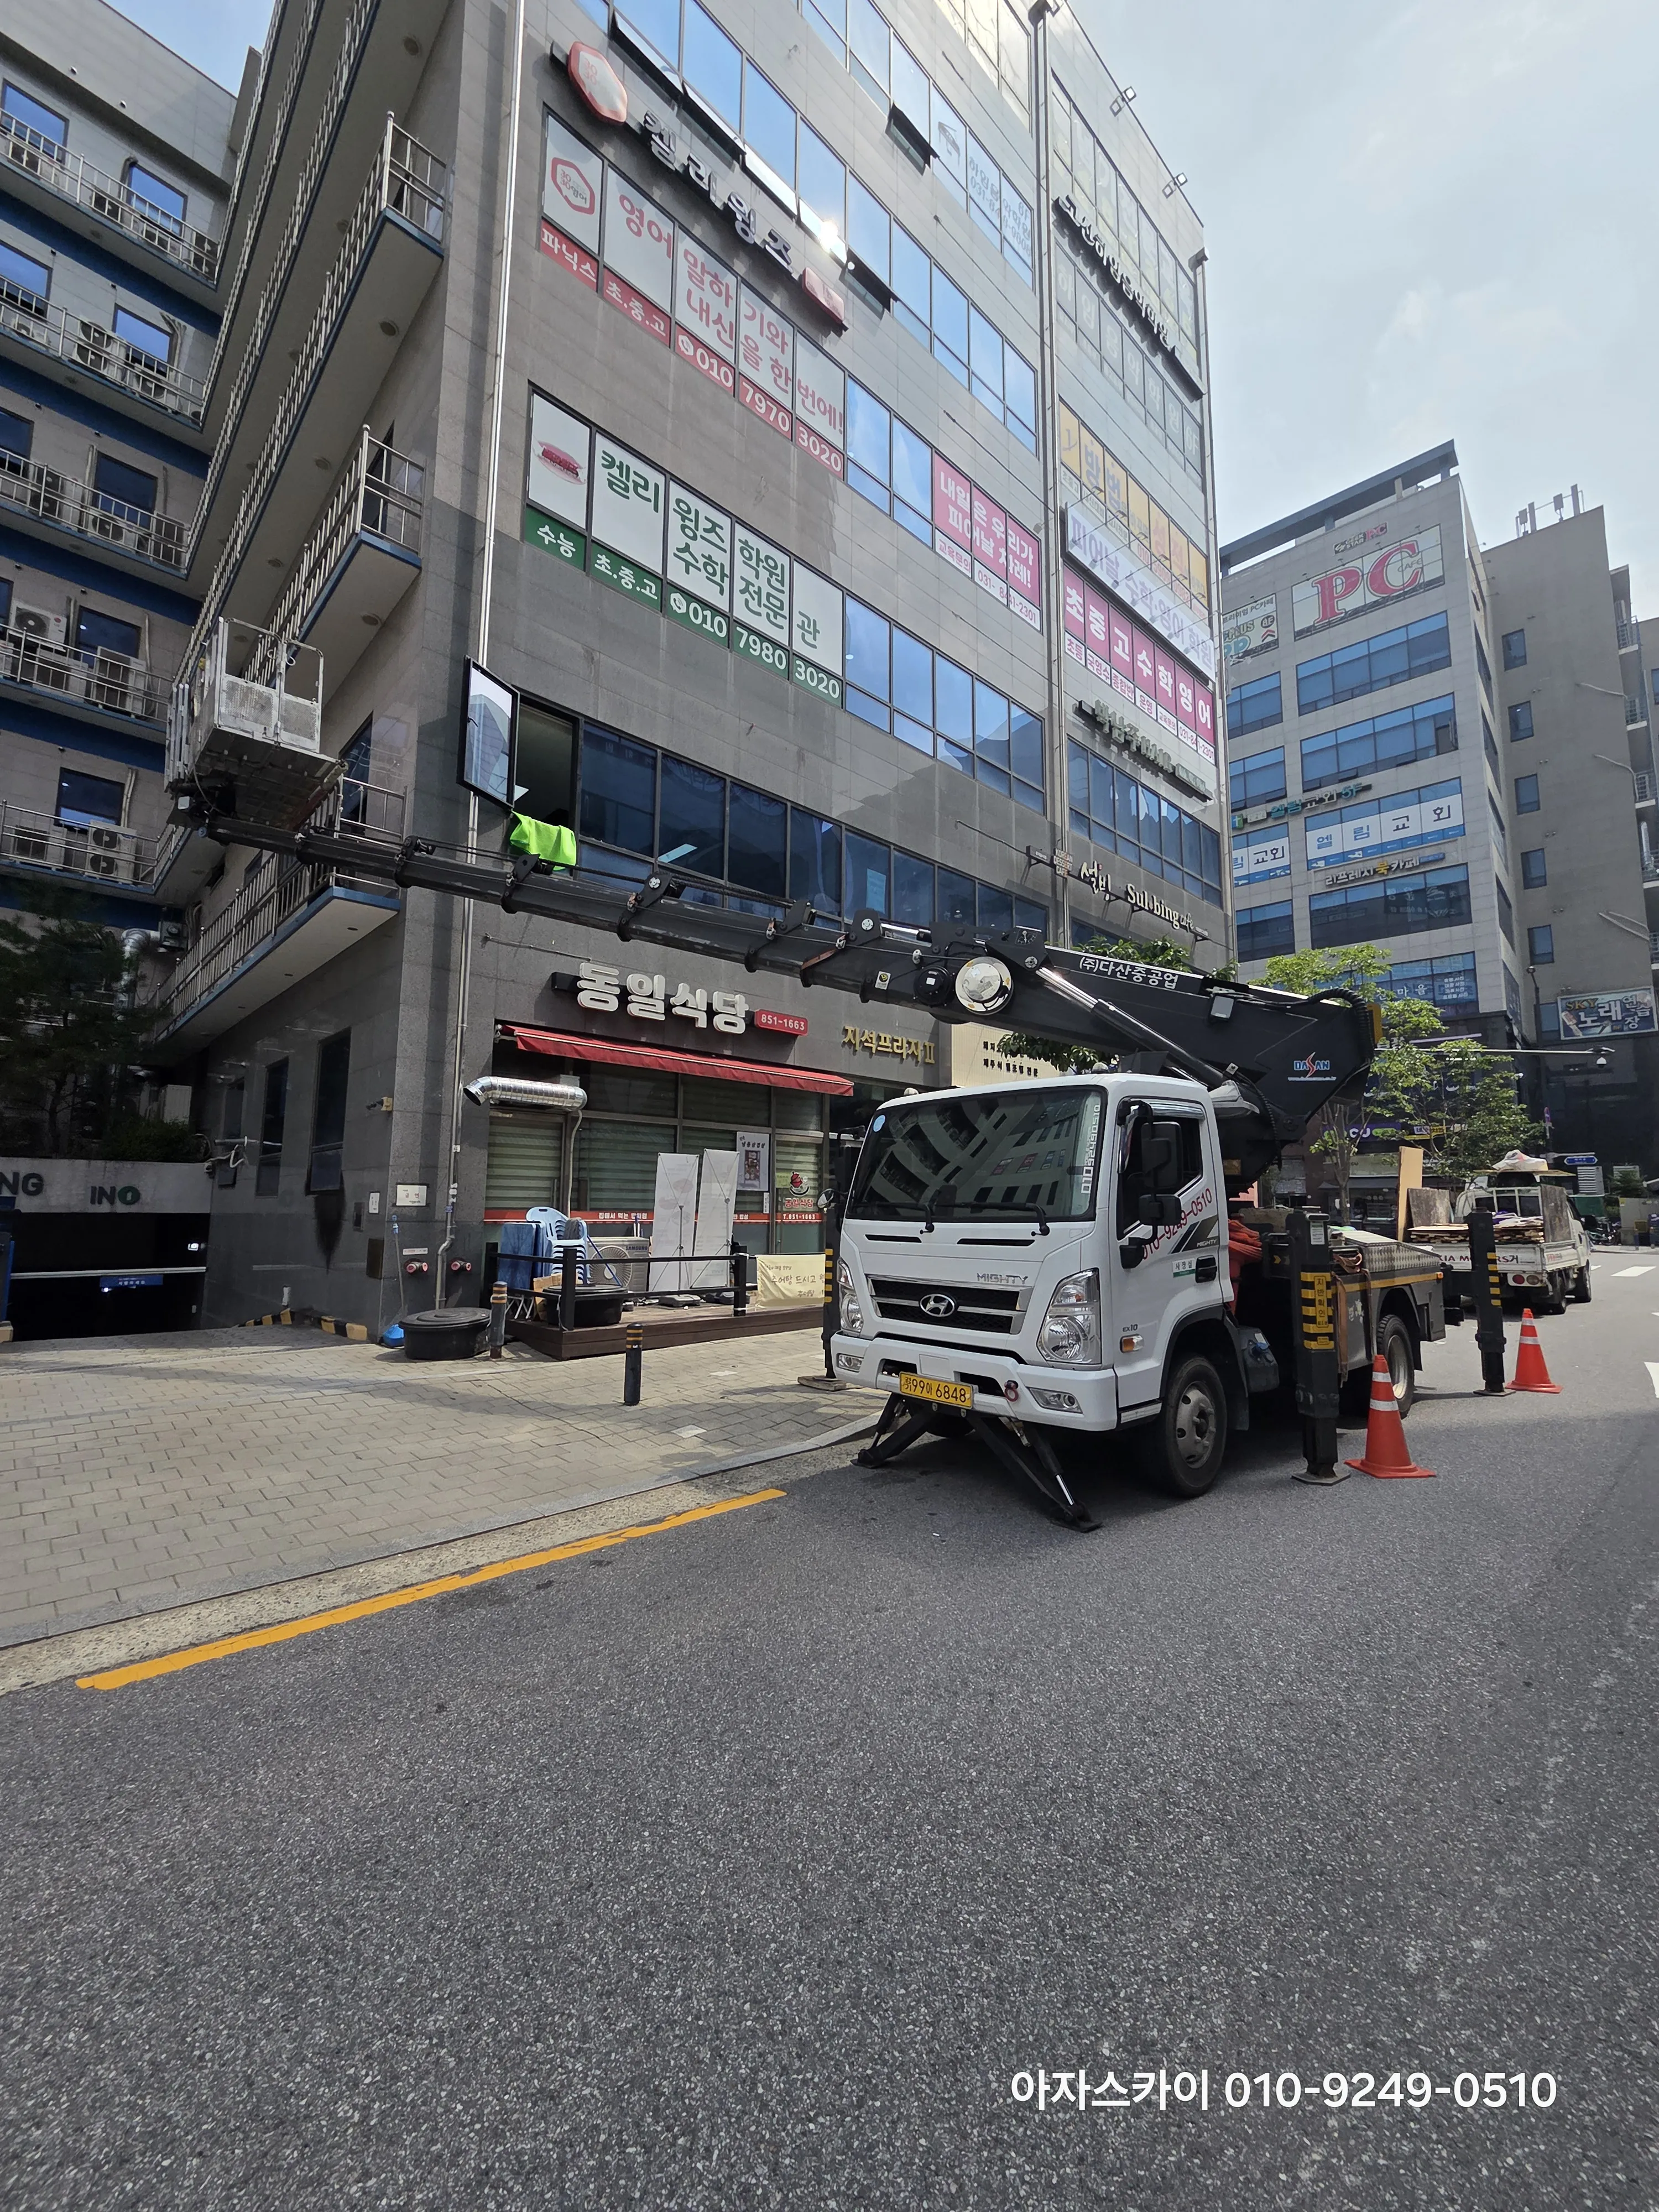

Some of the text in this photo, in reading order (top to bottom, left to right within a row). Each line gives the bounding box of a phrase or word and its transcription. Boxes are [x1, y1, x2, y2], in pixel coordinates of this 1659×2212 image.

[619, 194, 671, 259] 영어
[686, 288, 763, 372] 내신을
[541, 228, 597, 283] 파닉스
[696, 347, 734, 388] 010
[742, 381, 790, 432] 7970
[798, 426, 842, 472] 3020
[940, 471, 1033, 566] 내일은 우리가
[938, 539, 971, 574] 교육문의
[948, 504, 1031, 588] 피어날 차례!
[1346, 538, 1364, 549] STAR
[1397, 557, 1422, 573] CAFE
[1071, 514, 1120, 585] 피어날
[1187, 627, 1213, 670] 학원
[1311, 540, 1424, 627] PC
[536, 524, 841, 699] 수능 초.중.고 010 7980 3020
[1066, 638, 1083, 661] 초등
[1087, 652, 1111, 678] 국영수
[1112, 671, 1135, 701] 종합반
[1139, 694, 1153, 714] 운영
[1271, 789, 1337, 819] 엘림교회
[1341, 782, 1363, 800] 5F
[1056, 865, 1068, 878] CAFE
[1081, 860, 1111, 901] 설빙
[1079, 956, 1179, 989] (주)다산중공업
[577, 962, 806, 1035] 동일식당 851-1663
[1566, 998, 1599, 1011] SKY
[842, 1026, 923, 1062] 지석프라자
[1293, 1051, 1331, 1078] DASAN
[1349, 1128, 1371, 1138] CU
[90, 1186, 116, 1205] IN
[785, 1197, 814, 1208] 동일식당
[795, 1275, 817, 1284] 드시고
[976, 1272, 1029, 1285] MIGHTY
[1173, 1260, 1193, 1271] 사장실
[935, 1383, 967, 1403] 6848
